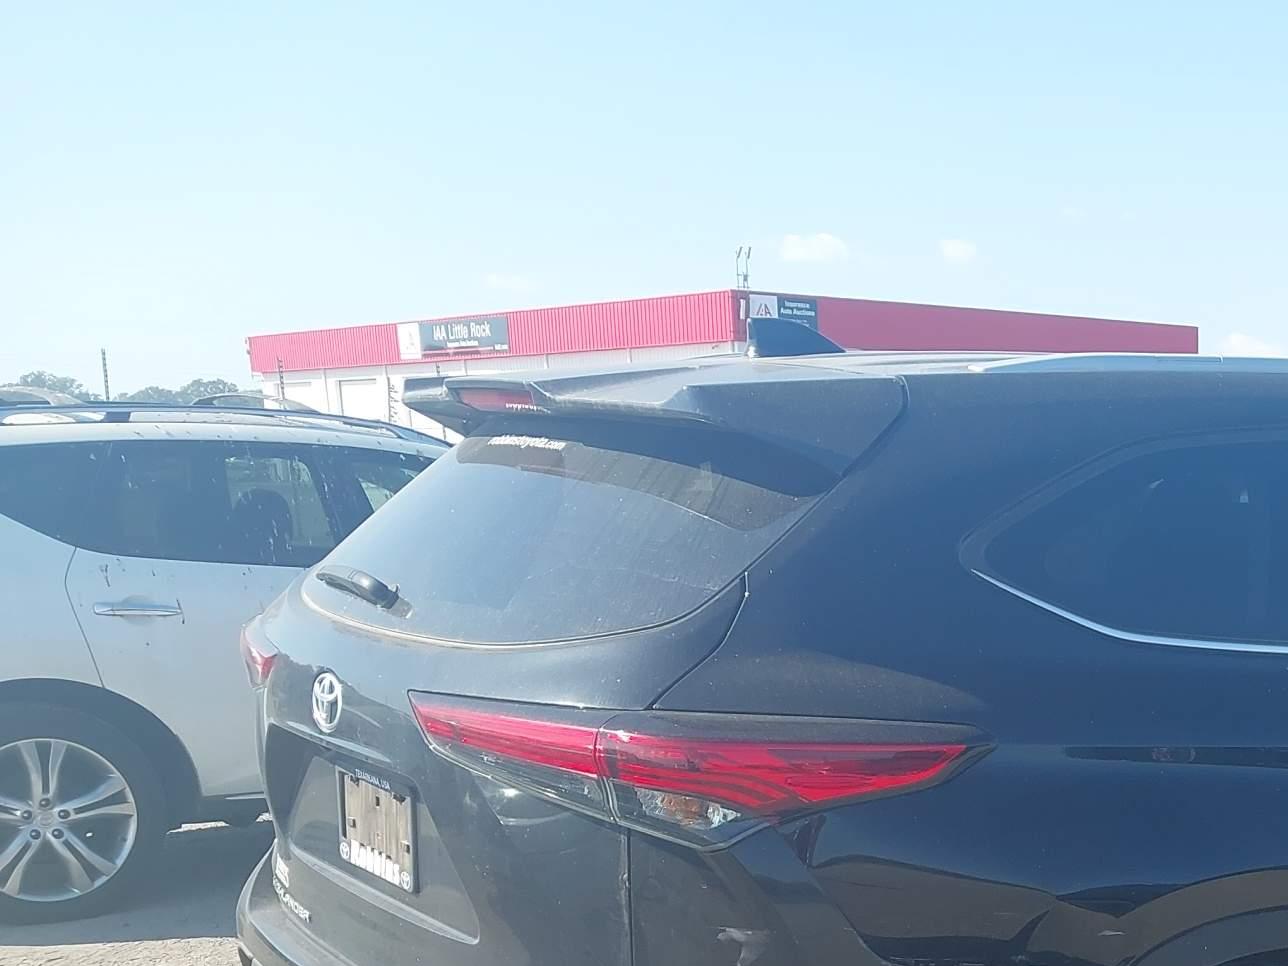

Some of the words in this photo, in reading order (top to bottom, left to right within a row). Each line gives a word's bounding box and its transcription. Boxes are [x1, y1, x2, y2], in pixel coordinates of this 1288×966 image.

[433, 325, 447, 341] IAA
[447, 322, 469, 340] Little
[470, 321, 492, 338] Rock
